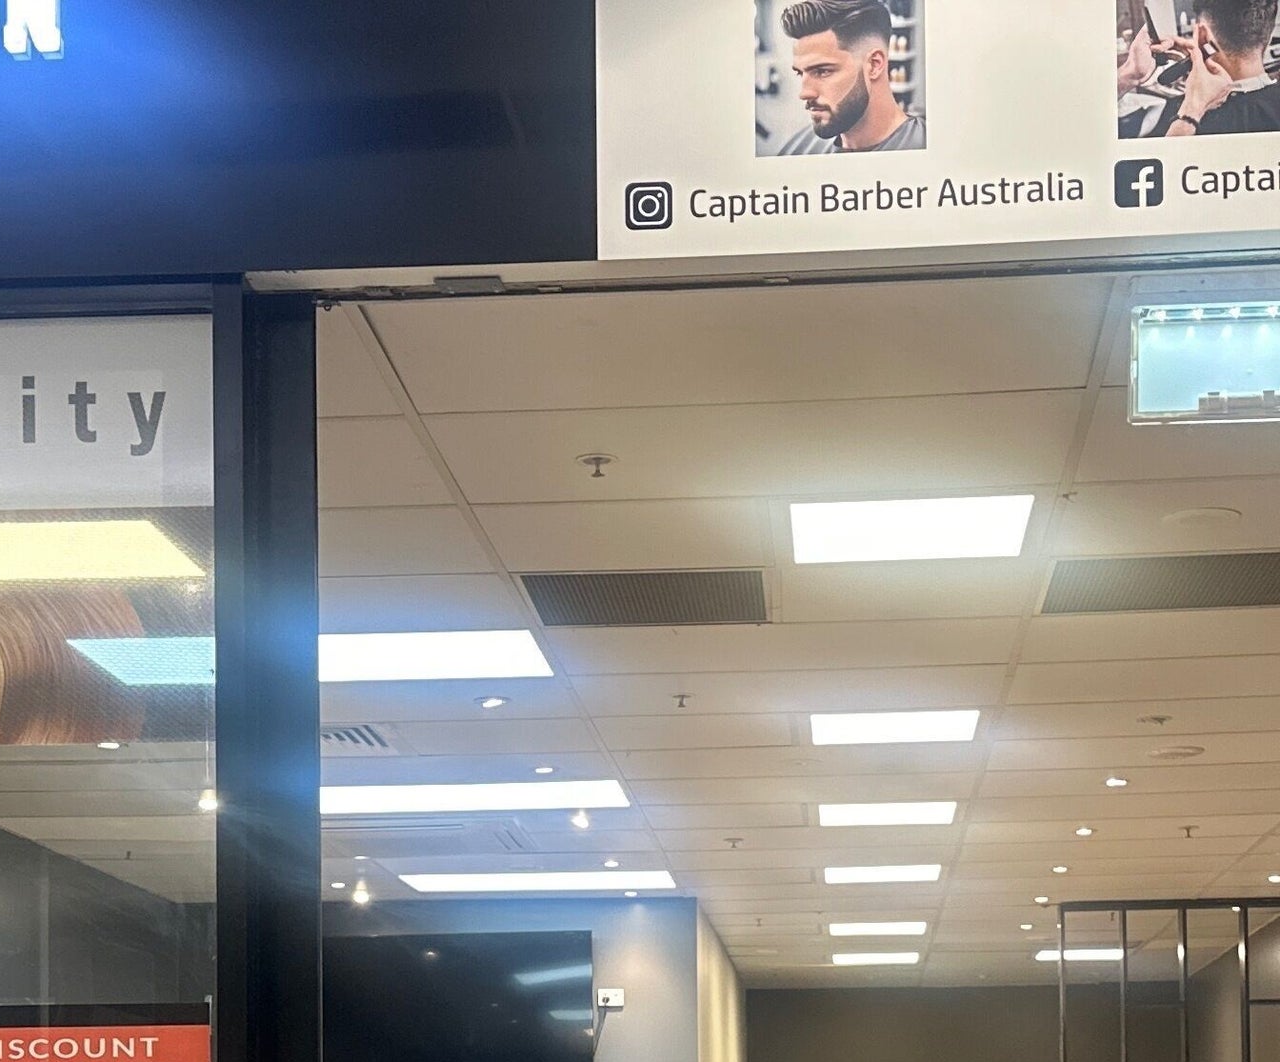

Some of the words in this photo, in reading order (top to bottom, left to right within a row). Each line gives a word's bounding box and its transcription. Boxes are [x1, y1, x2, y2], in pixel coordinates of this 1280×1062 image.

[688, 183, 811, 224] Captain
[820, 179, 928, 214] Barber
[937, 171, 1086, 209] Australia
